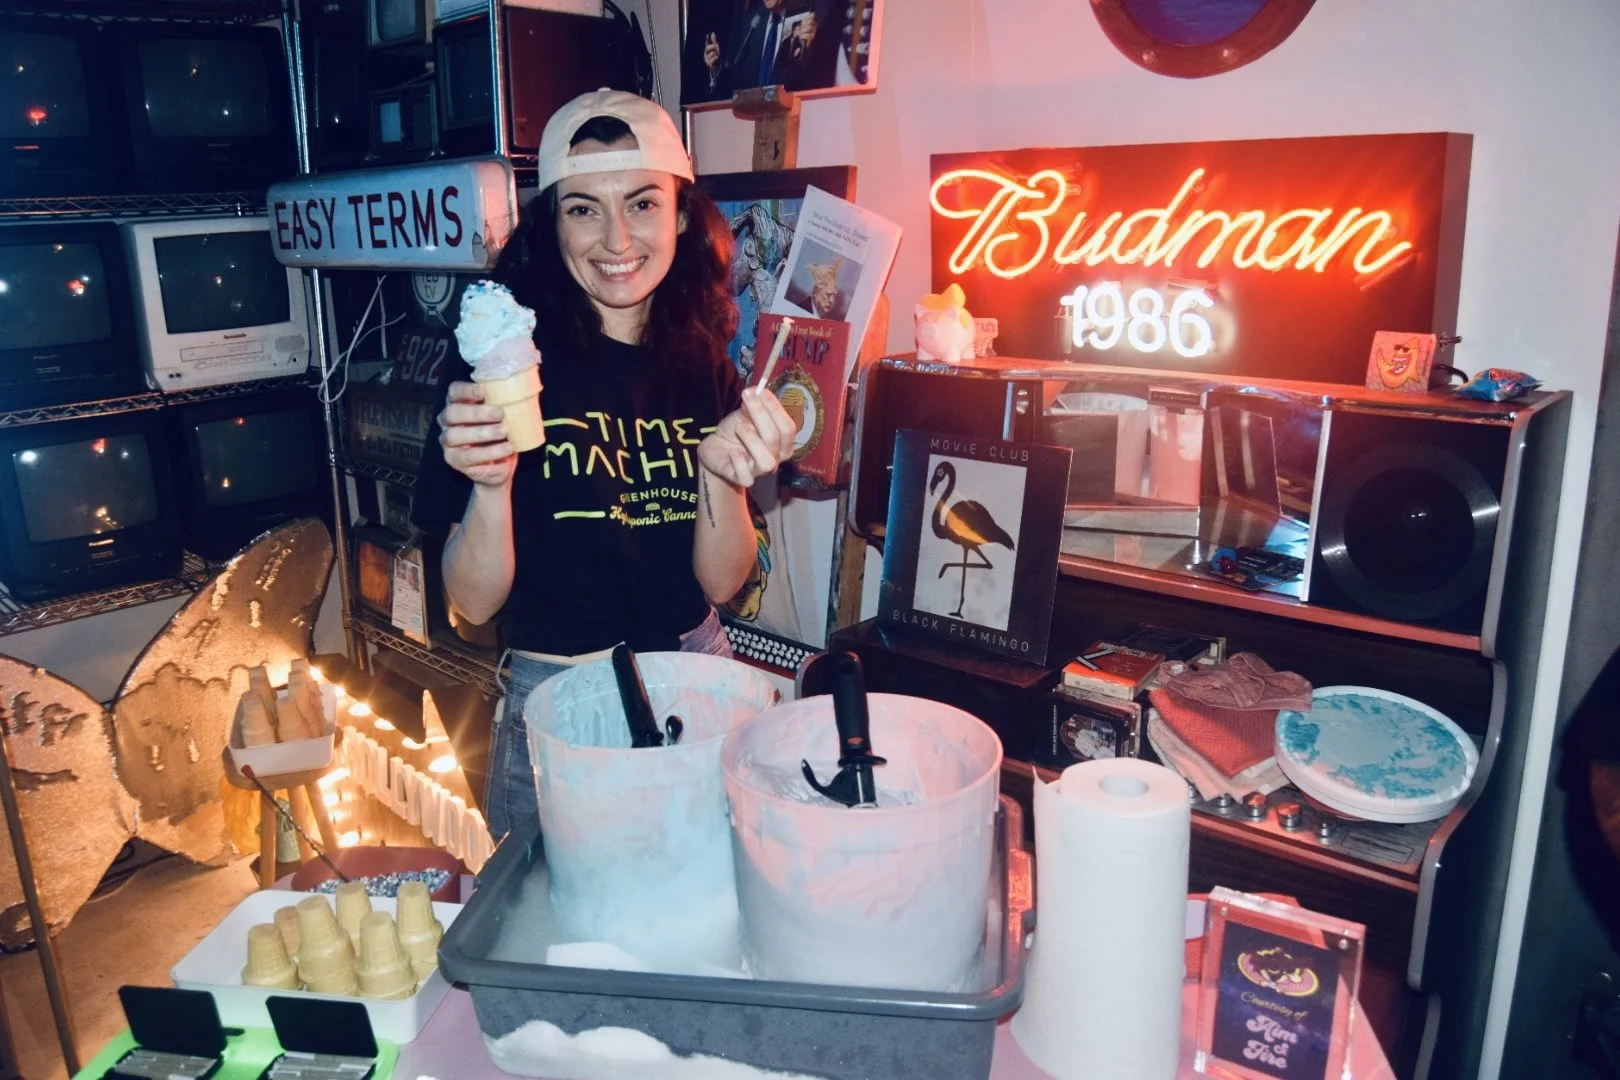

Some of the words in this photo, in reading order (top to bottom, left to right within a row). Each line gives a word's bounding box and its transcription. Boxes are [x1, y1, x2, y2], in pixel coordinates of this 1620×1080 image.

[274, 197, 336, 250] EASY
[347, 185, 463, 249] TERMS
[929, 167, 1412, 279] Budman
[1060, 281, 1215, 358] 1986
[769, 331, 831, 366] RUMP
[585, 412, 700, 448] TIME
[930, 438, 977, 455] MOVIE
[989, 446, 1030, 462] CLUB
[893, 610, 939, 631] BLACK
[950, 623, 1029, 653] FLAMINGO
